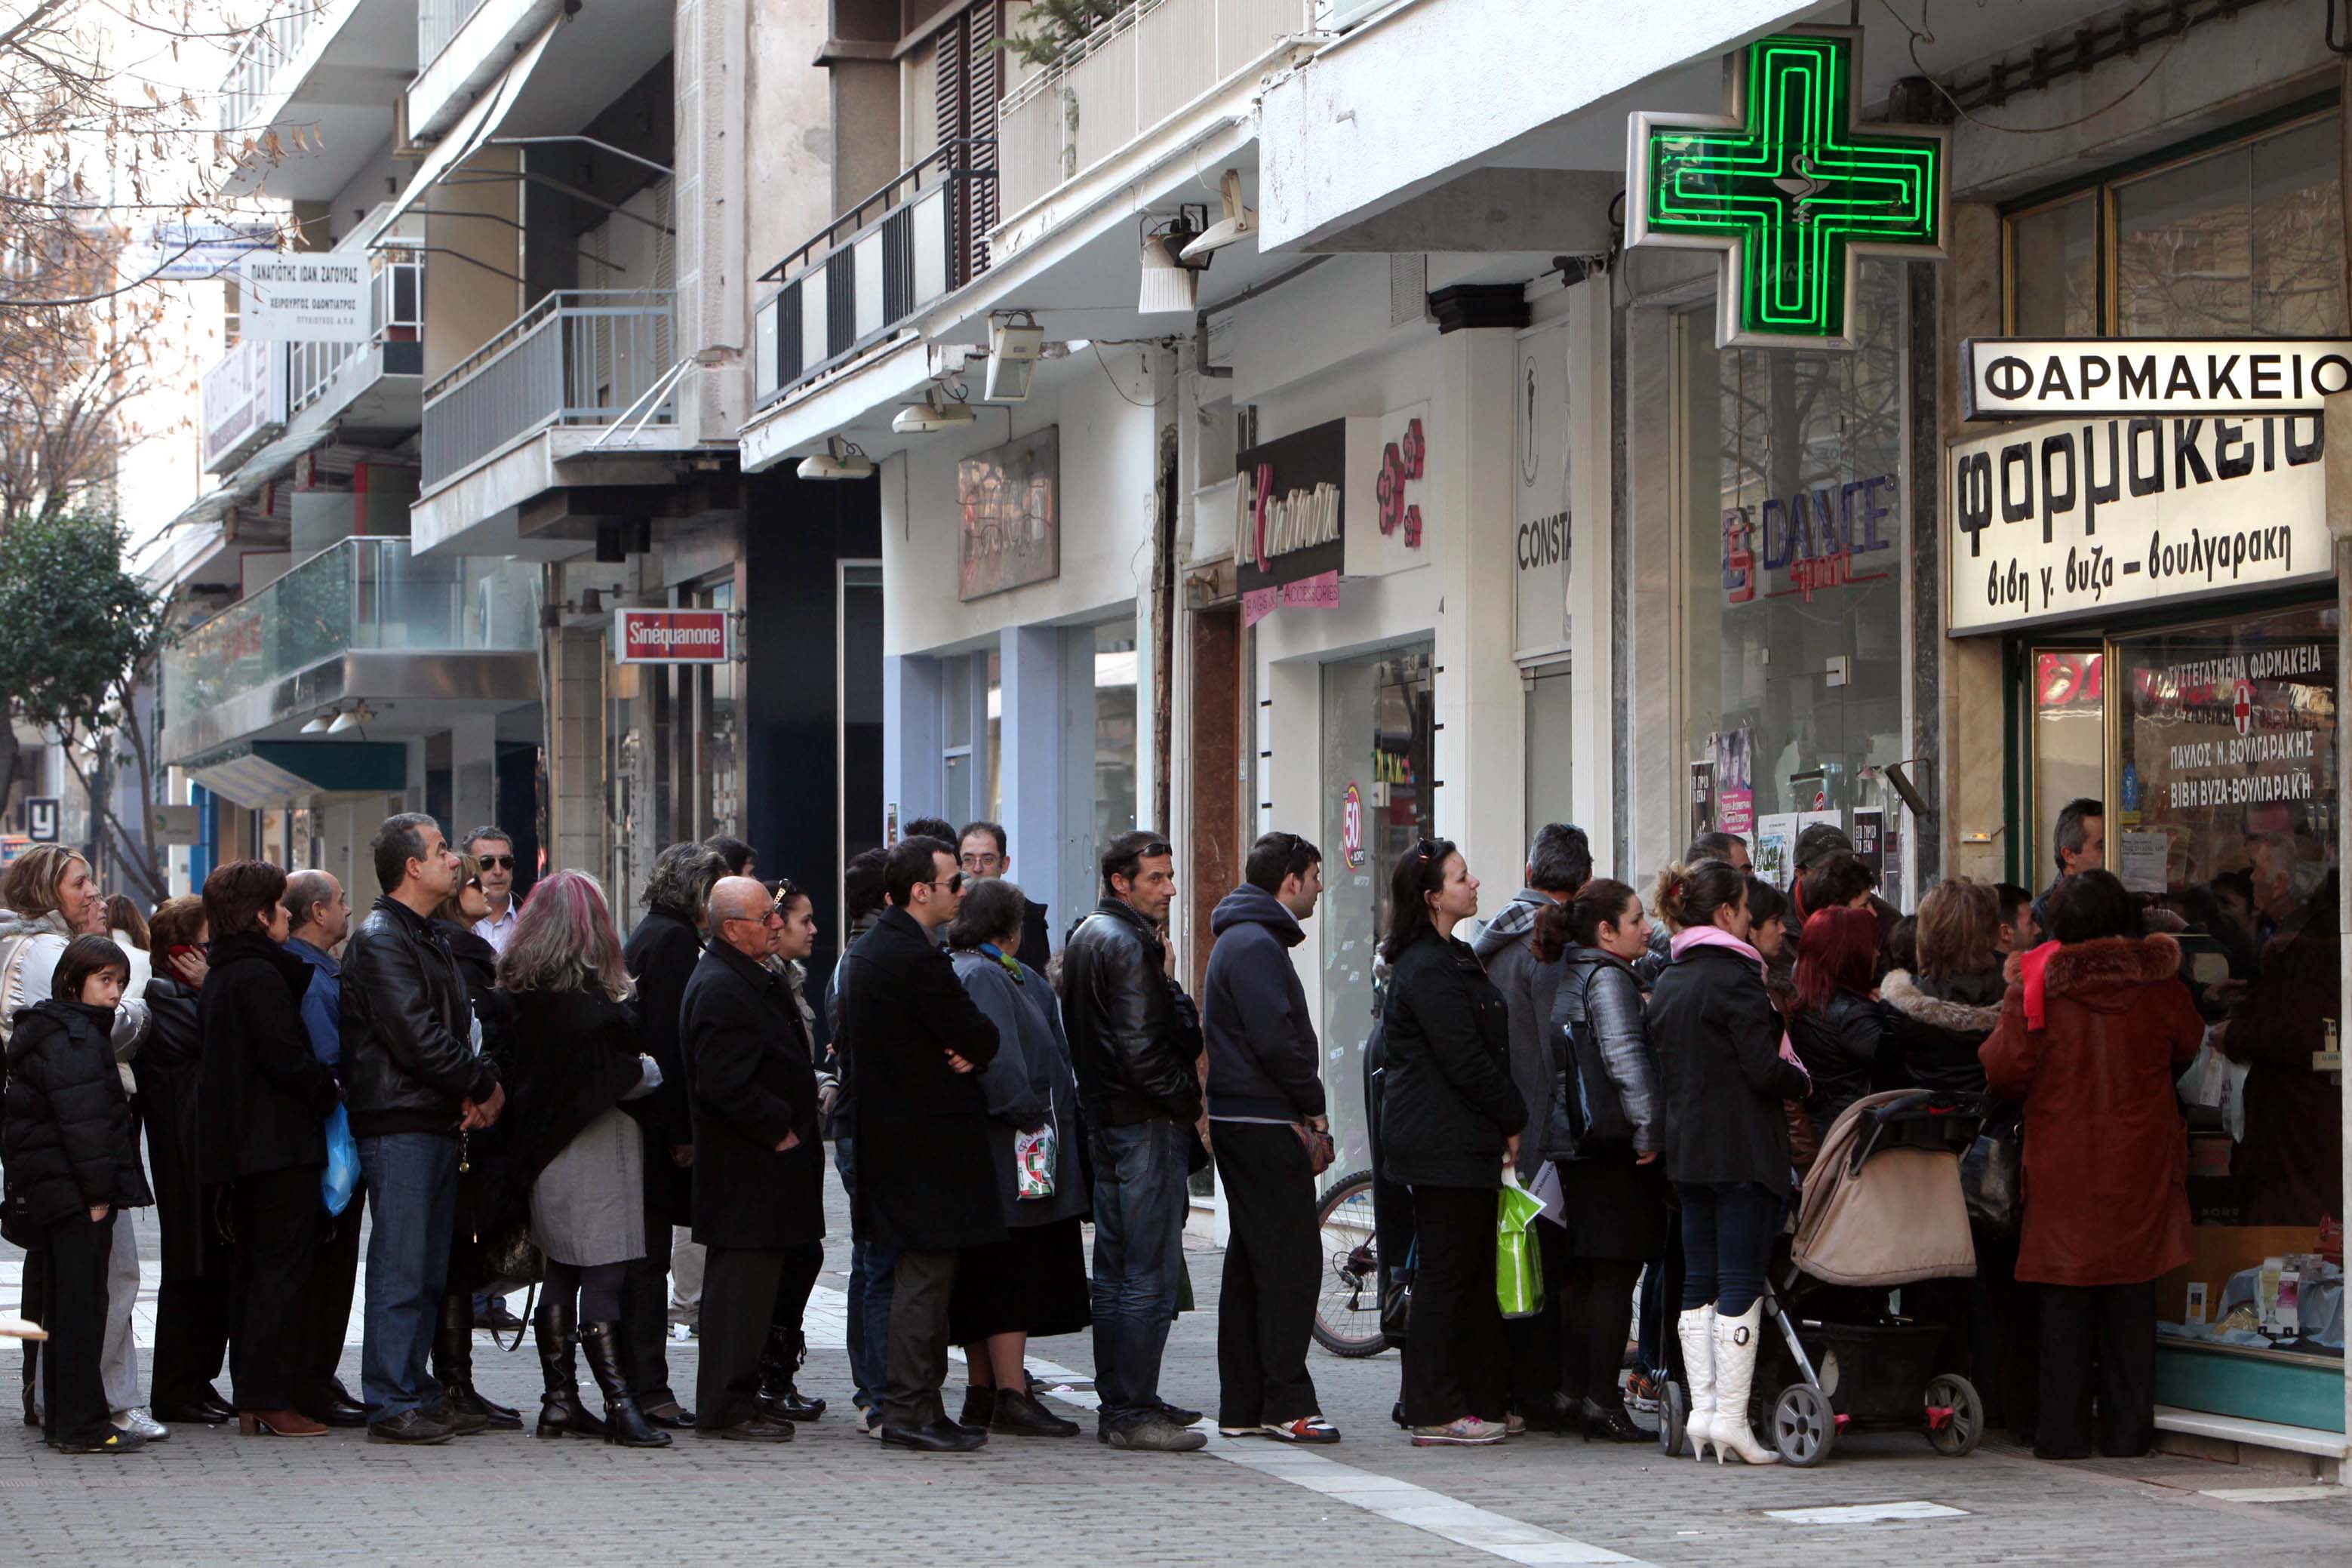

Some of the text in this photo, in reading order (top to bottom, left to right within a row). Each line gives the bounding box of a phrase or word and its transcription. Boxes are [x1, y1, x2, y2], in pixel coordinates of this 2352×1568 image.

[321, 266, 358, 284] ΖΑΓΟΥΡΑΣ
[270, 298, 356, 310] ΧΕΙΡΟΥΡΓΟΣ ΟΔΟΝΤΙΑΤΡΟΣ
[1985, 354, 2352, 401] ΦΑΡΜΑΚΕΙΟ
[1763, 476, 1889, 570] DANCE
[1284, 584, 1339, 603] ACCESSORIES
[629, 621, 721, 651] Sinéquanone
[2168, 645, 2321, 688] ΣΥΣΤΕΓΑΣΜΕΝΑ ΦΑΡΜΑΚΕΙΑ
[2170, 742, 2212, 770] ΠΑΥΛΟΣ
[2230, 730, 2314, 765] ΒΟΥΛΓΑΡΑΚΗΣ
[2170, 781, 2197, 809] ΒΙΒΗ
[1345, 801, 1359, 848] 50
